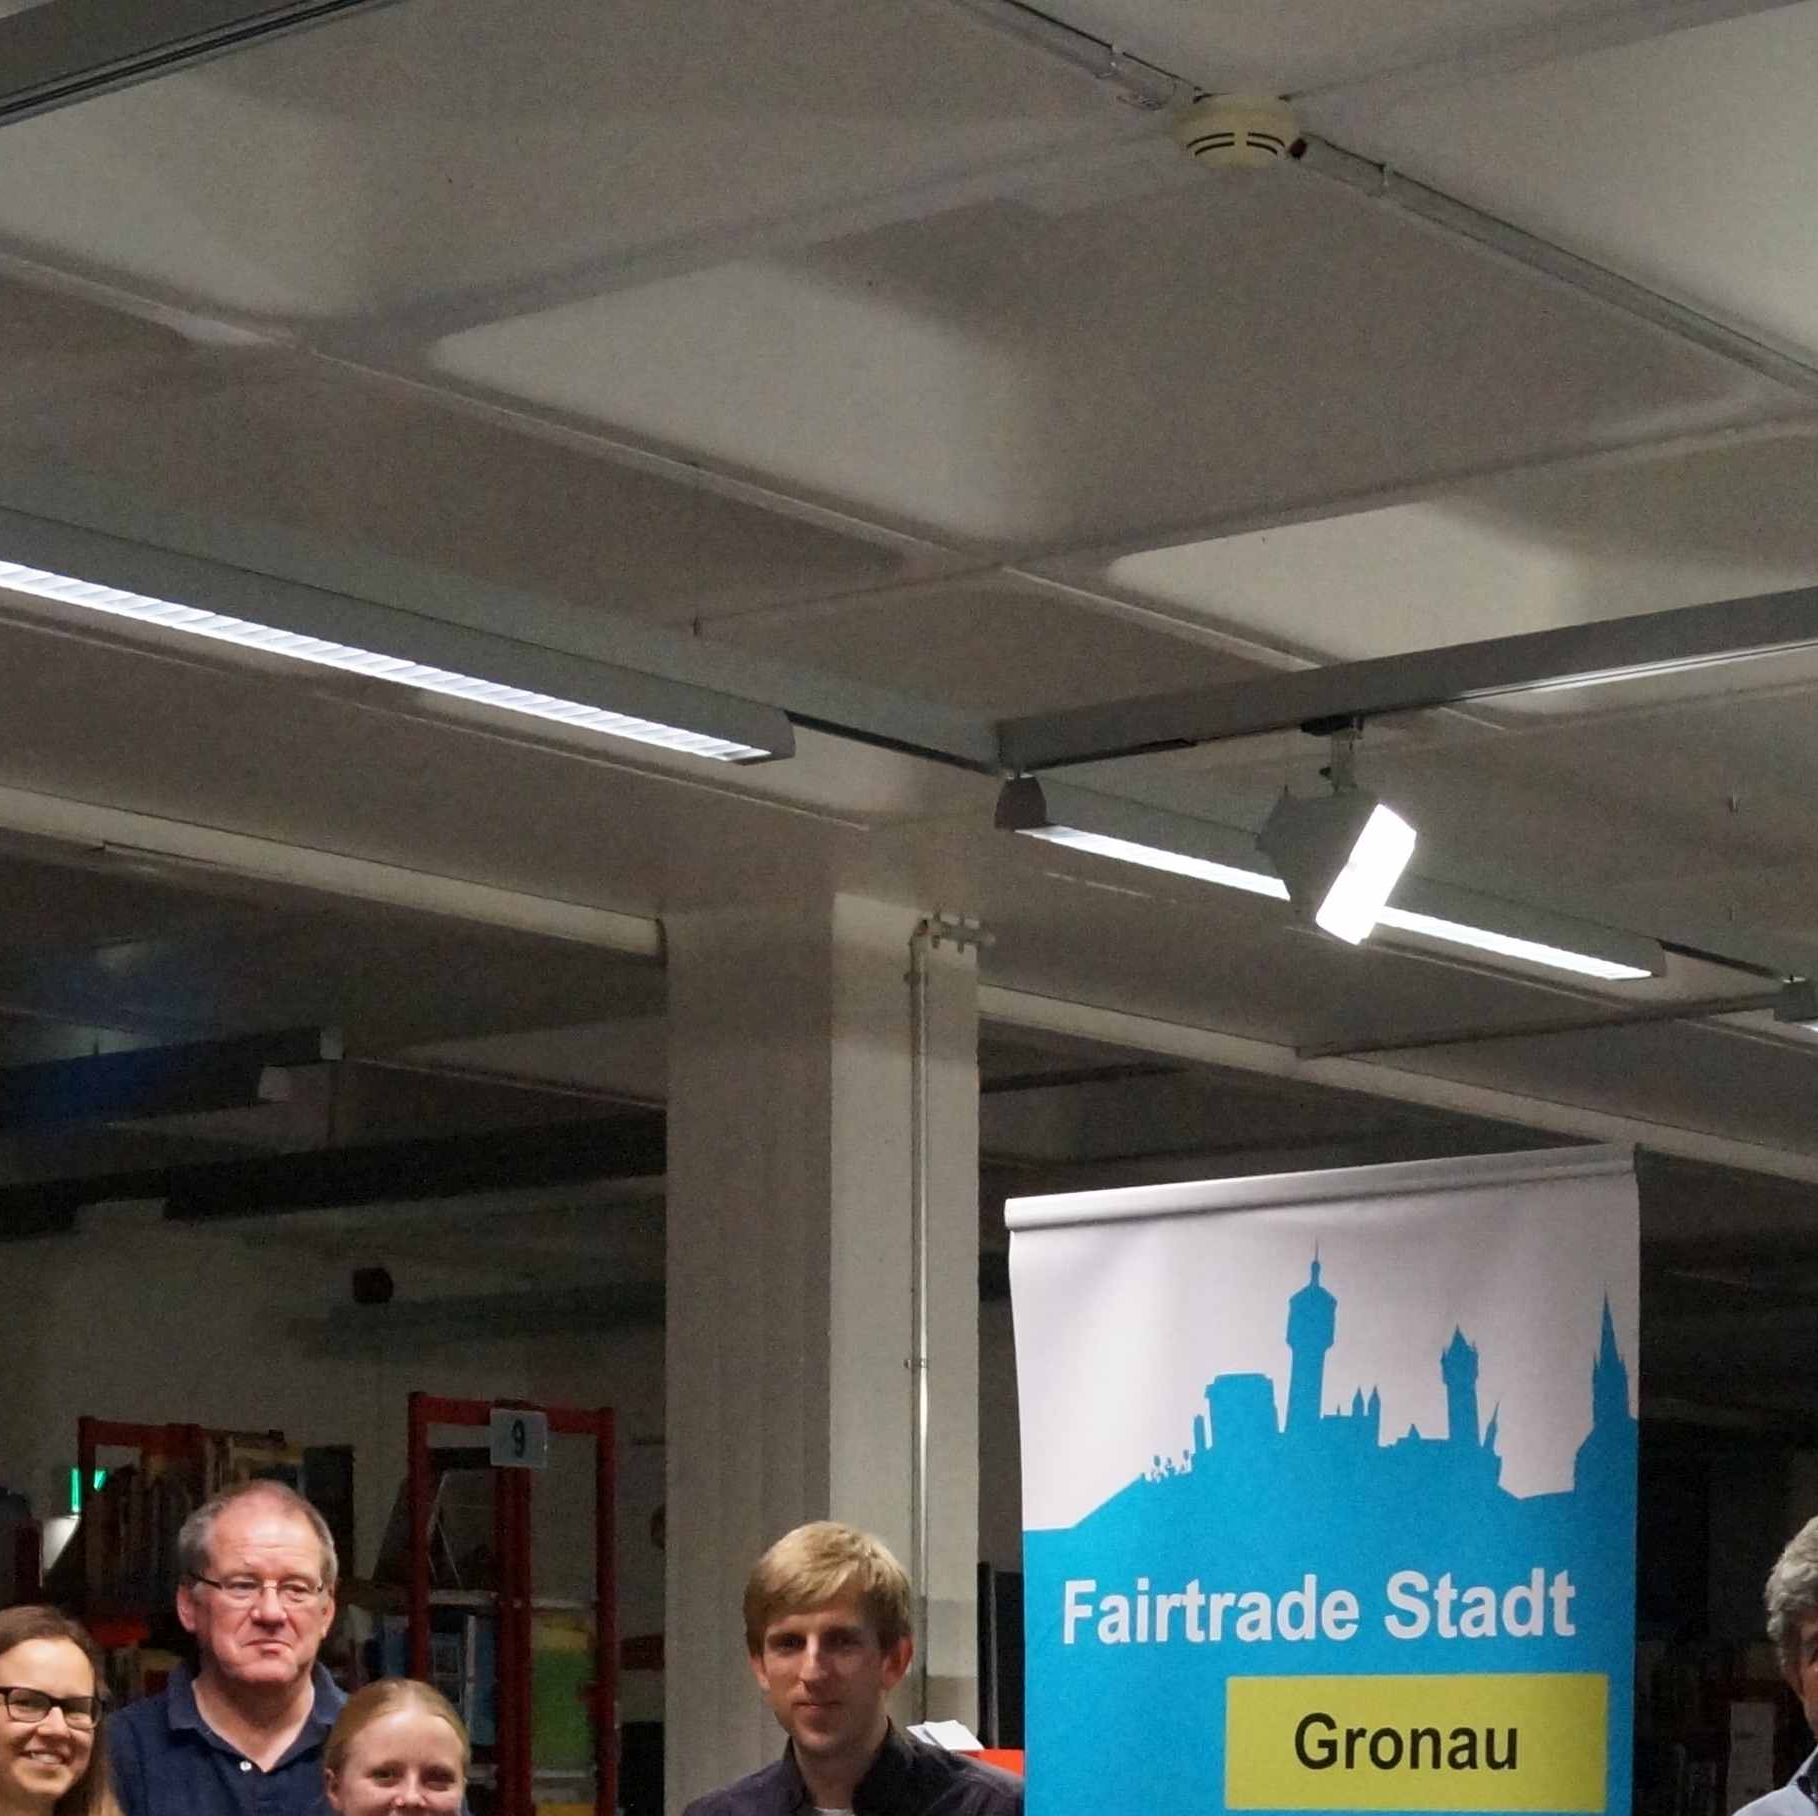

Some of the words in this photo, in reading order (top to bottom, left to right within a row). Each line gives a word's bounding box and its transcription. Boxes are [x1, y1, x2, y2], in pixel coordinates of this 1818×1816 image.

[510, 1418, 526, 1458] 9
[1062, 1573, 1359, 1644] Fairtrade
[1384, 1567, 1576, 1639] Stadt
[1293, 1712, 1518, 1770] Gronau
